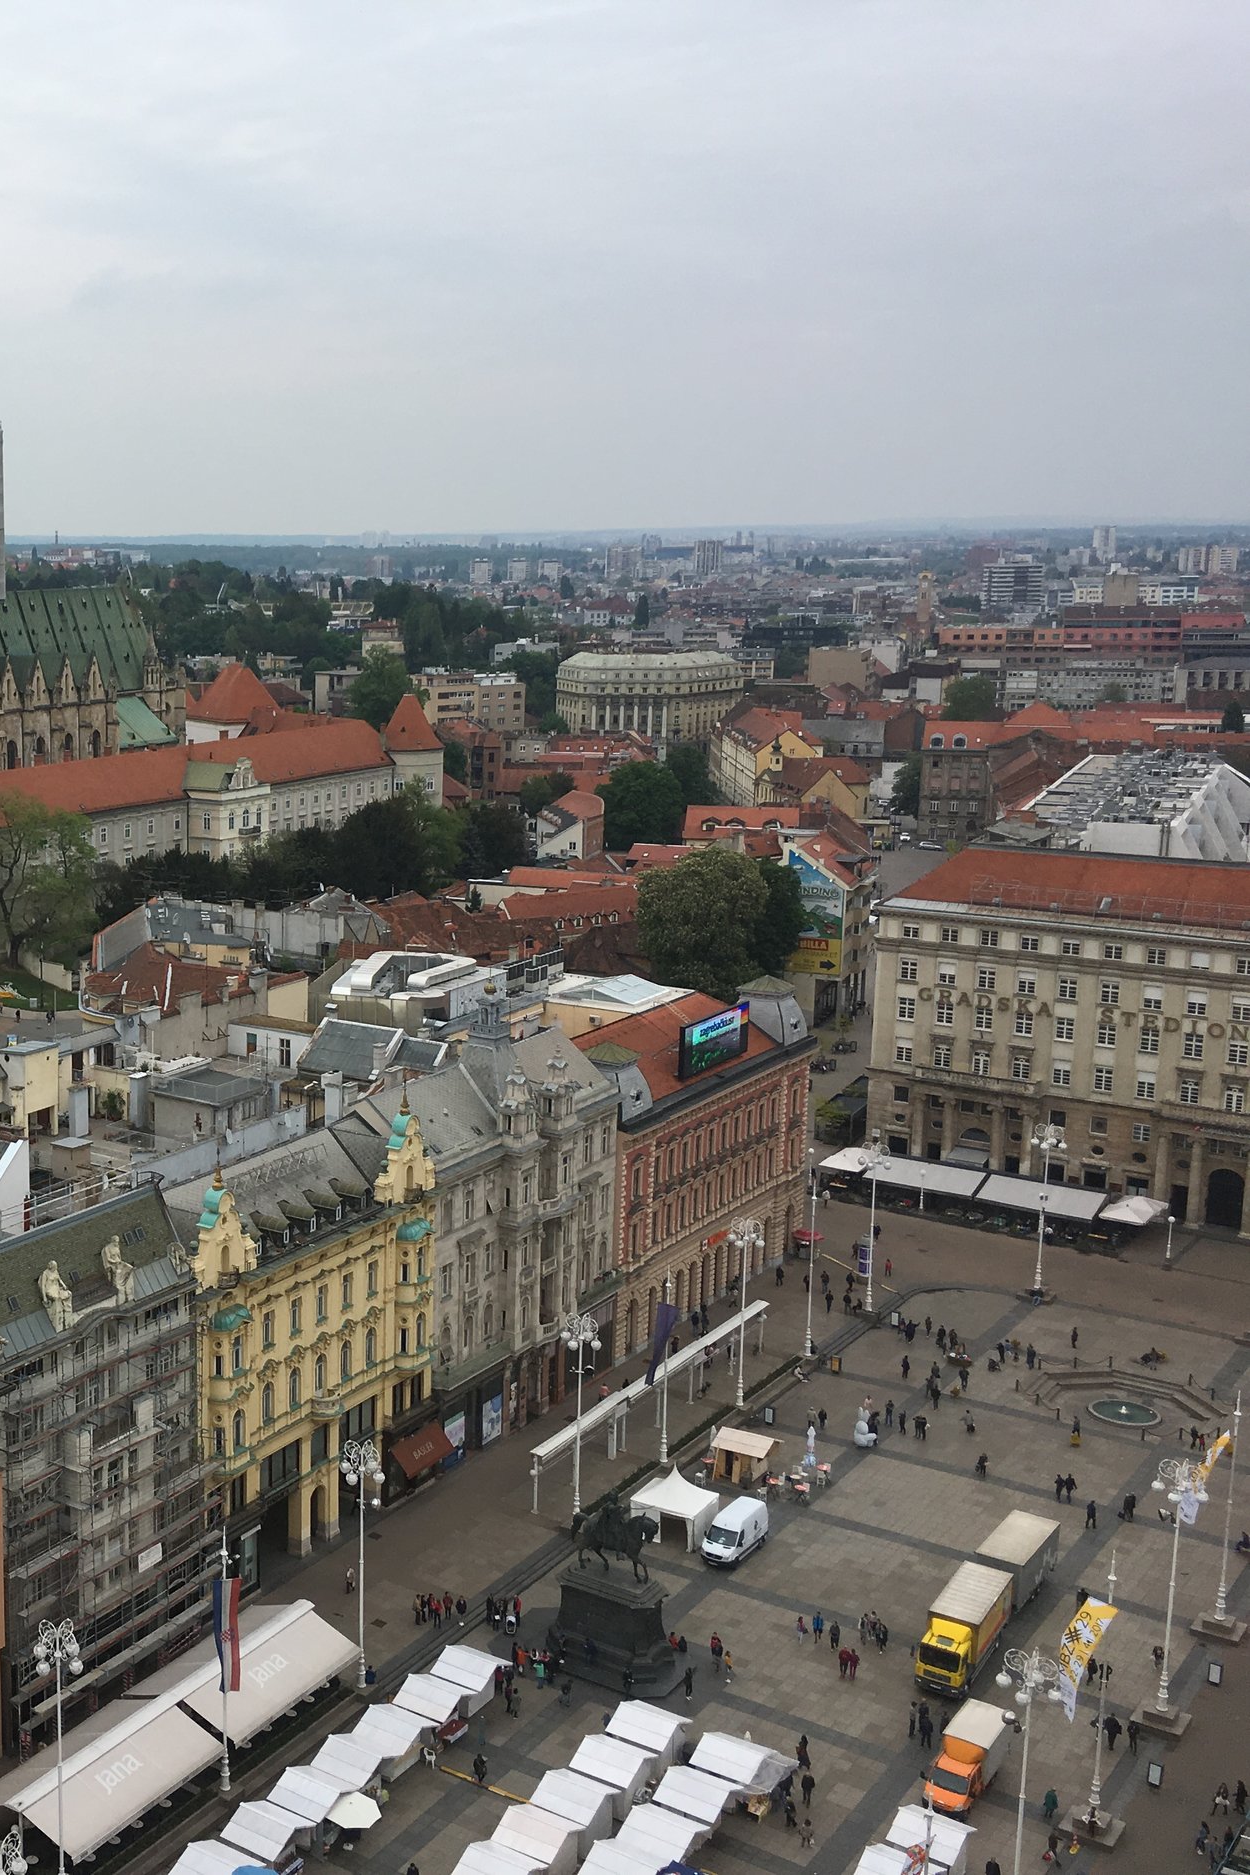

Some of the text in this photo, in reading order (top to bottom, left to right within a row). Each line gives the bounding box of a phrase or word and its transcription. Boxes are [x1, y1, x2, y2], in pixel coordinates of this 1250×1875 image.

[799, 940, 828, 950] BILLA
[248, 1653, 289, 1689] Jana
[94, 1754, 144, 1795] Jana
